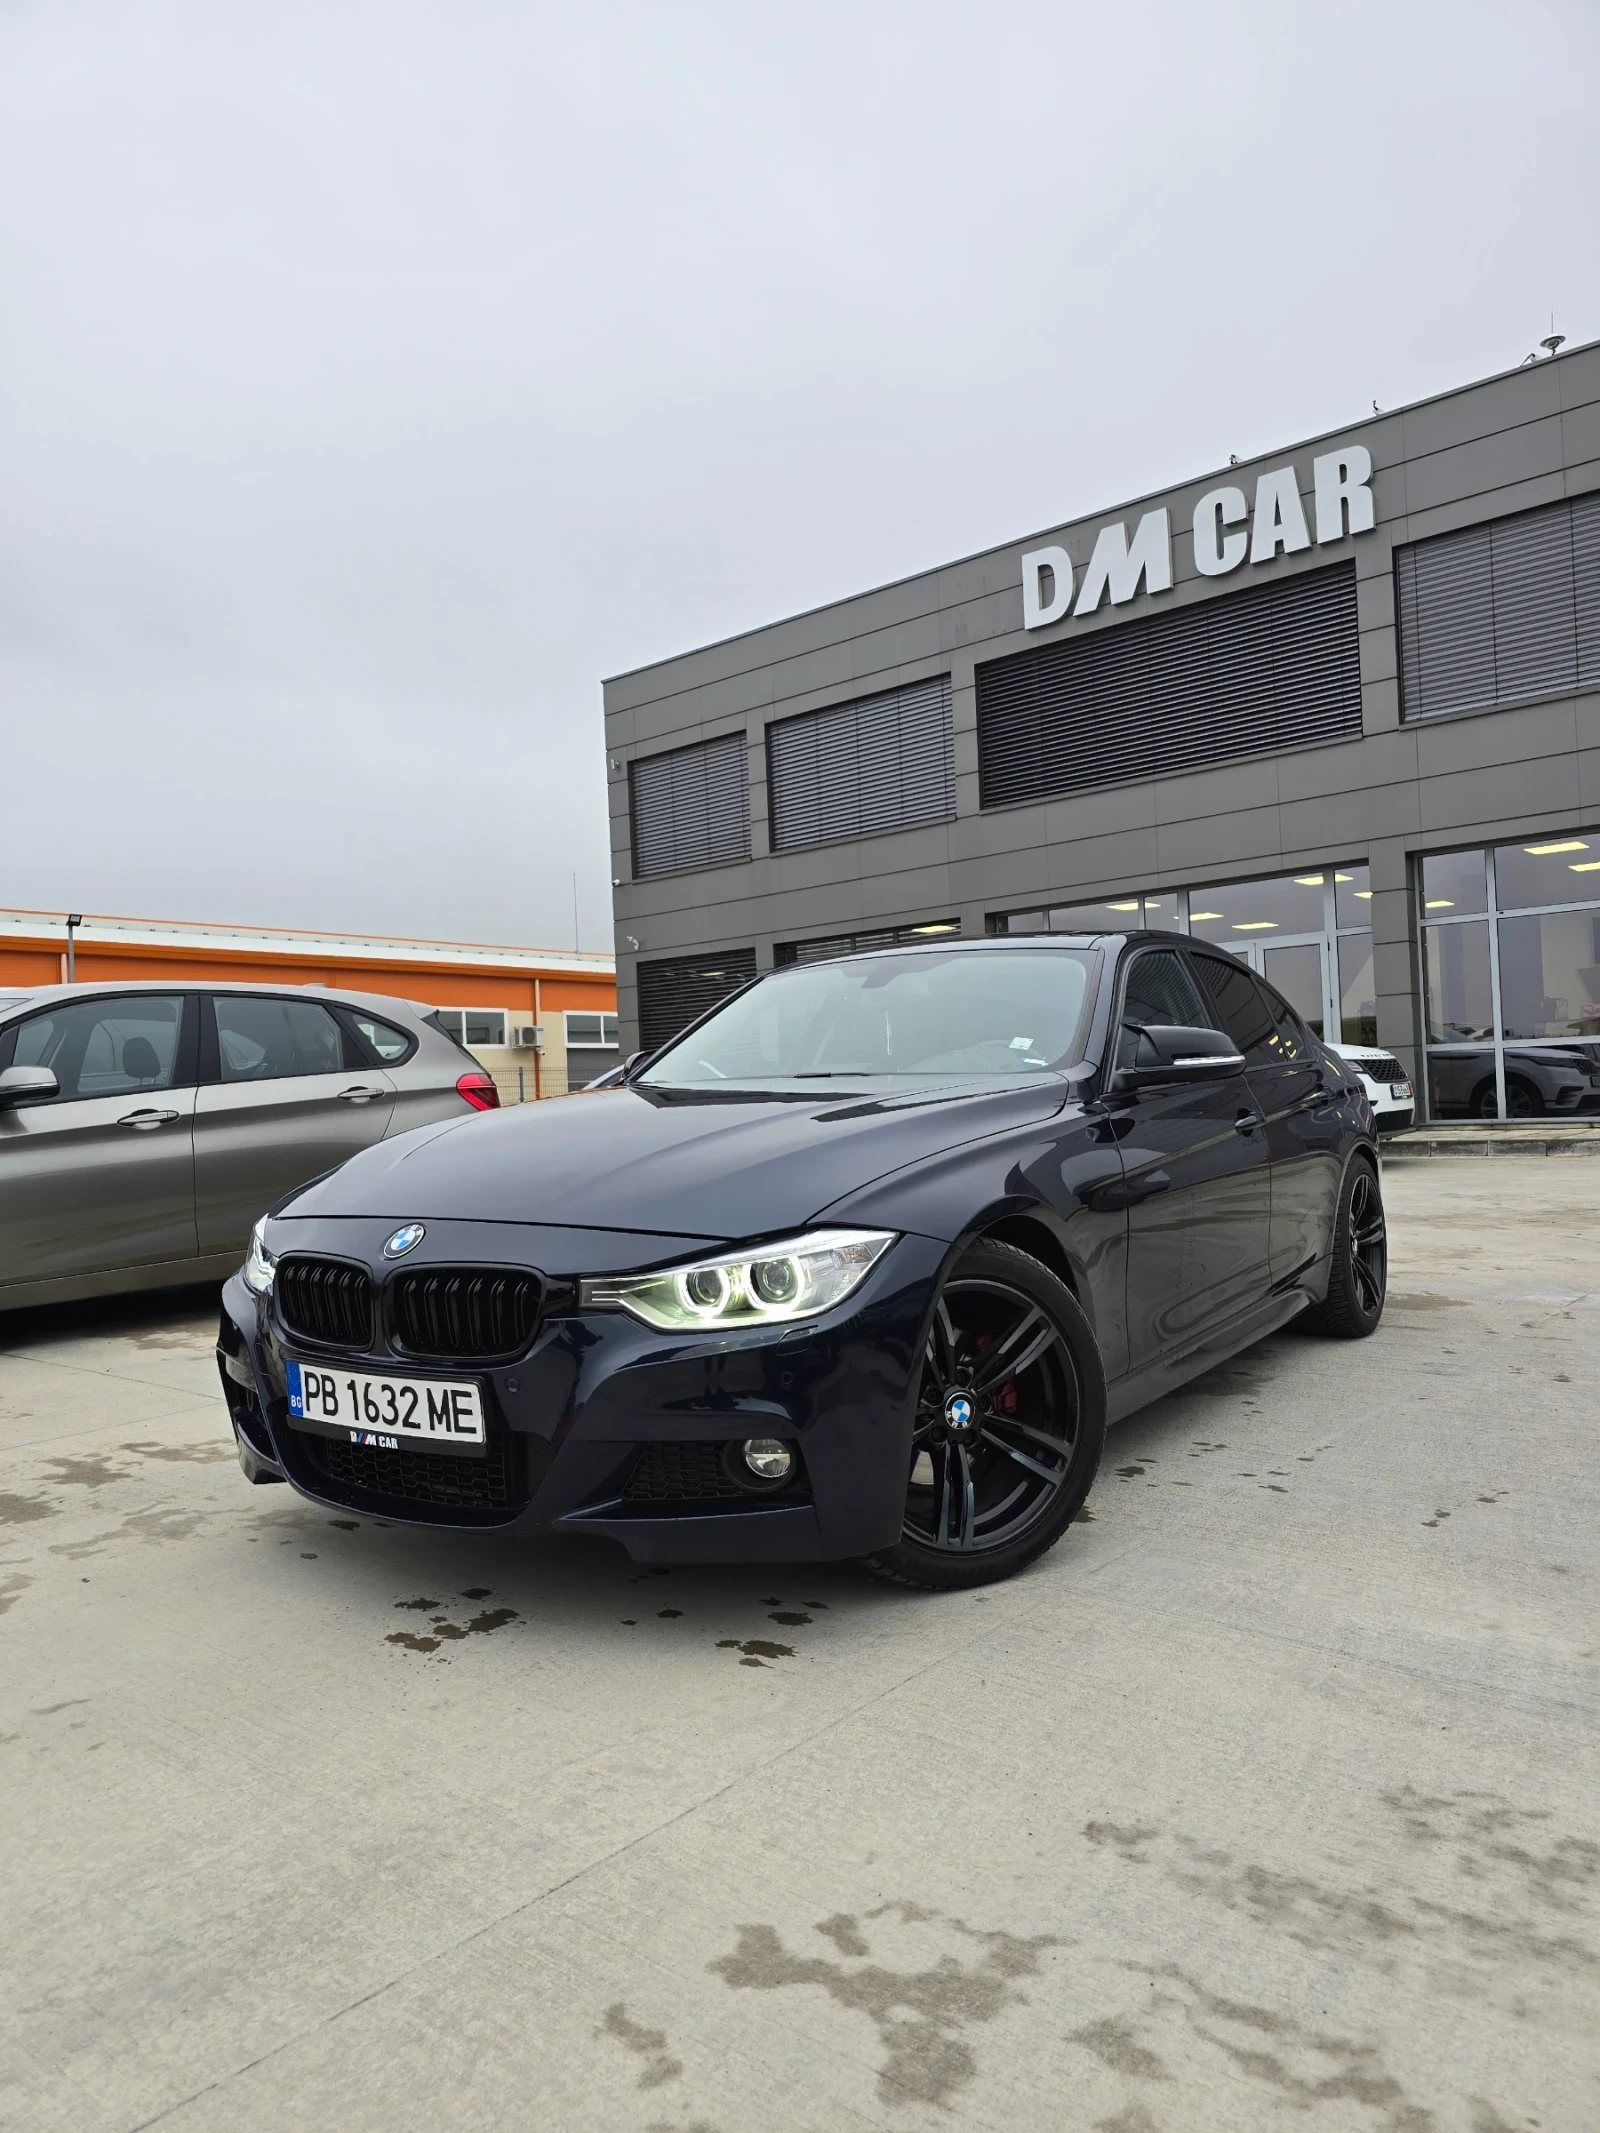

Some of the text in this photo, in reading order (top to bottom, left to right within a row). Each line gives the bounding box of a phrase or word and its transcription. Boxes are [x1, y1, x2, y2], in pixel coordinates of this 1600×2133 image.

[1021, 445, 1377, 632] DM CAR
[290, 1394, 303, 1408] BG
[304, 1371, 477, 1434] PB 1632 ME
[378, 1436, 399, 1449] CAR
